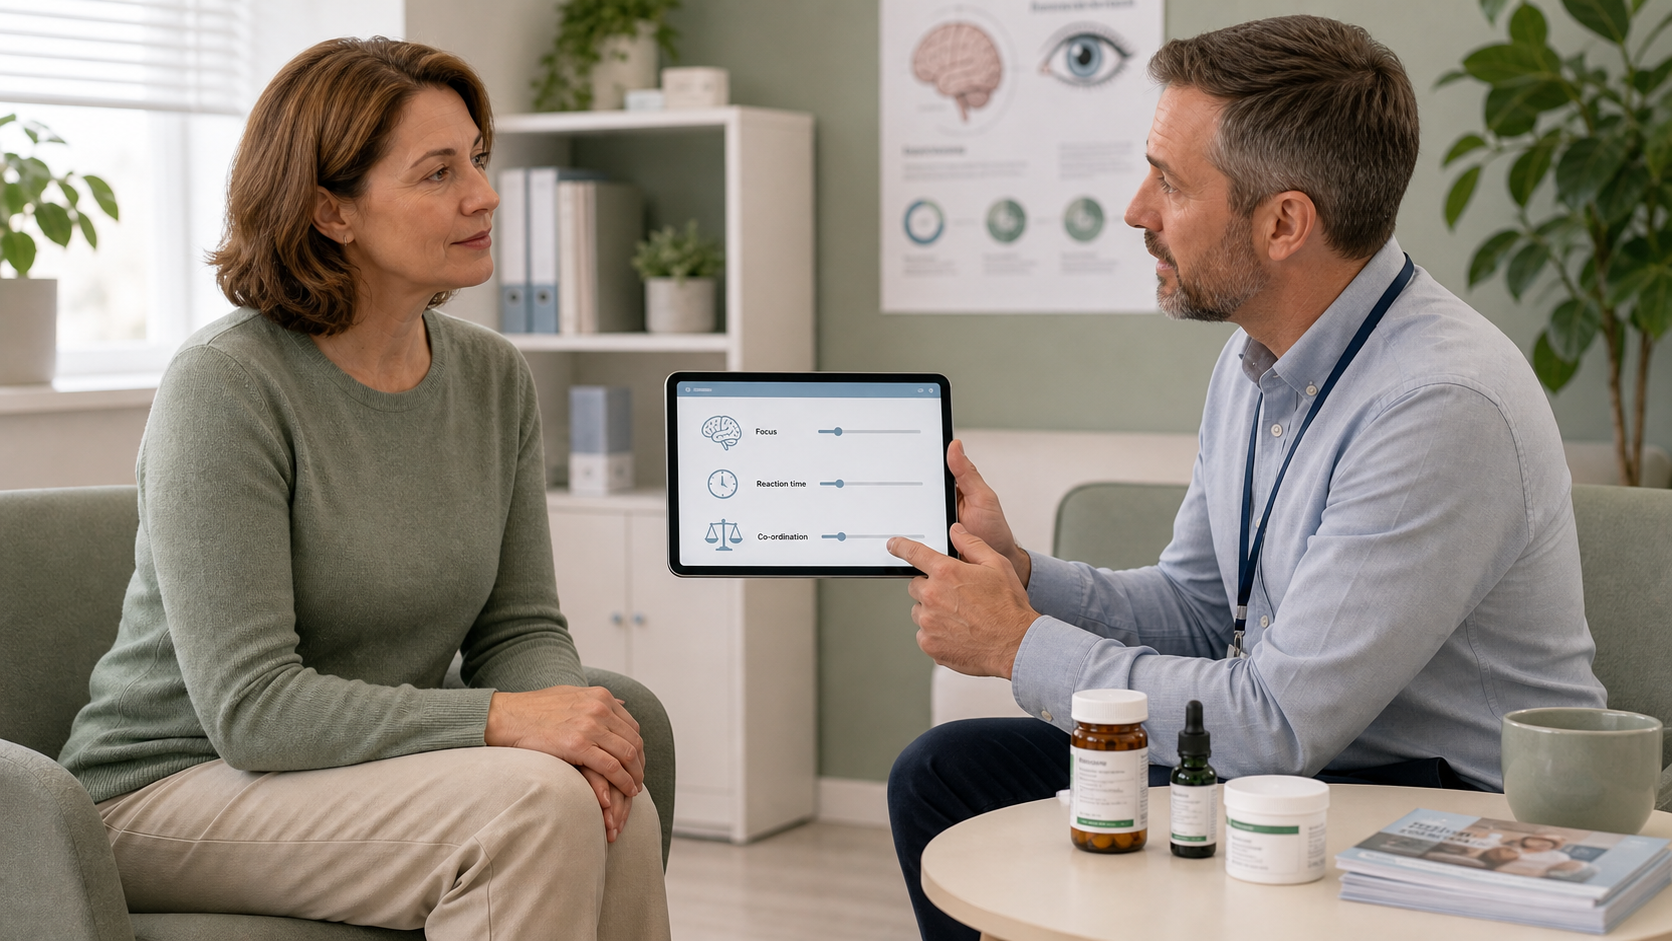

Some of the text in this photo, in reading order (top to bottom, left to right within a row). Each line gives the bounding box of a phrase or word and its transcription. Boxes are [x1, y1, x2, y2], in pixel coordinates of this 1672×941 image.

[755, 428, 777, 436] Focus
[756, 480, 807, 488] Reaction time
[757, 532, 809, 541] Co-ordination
